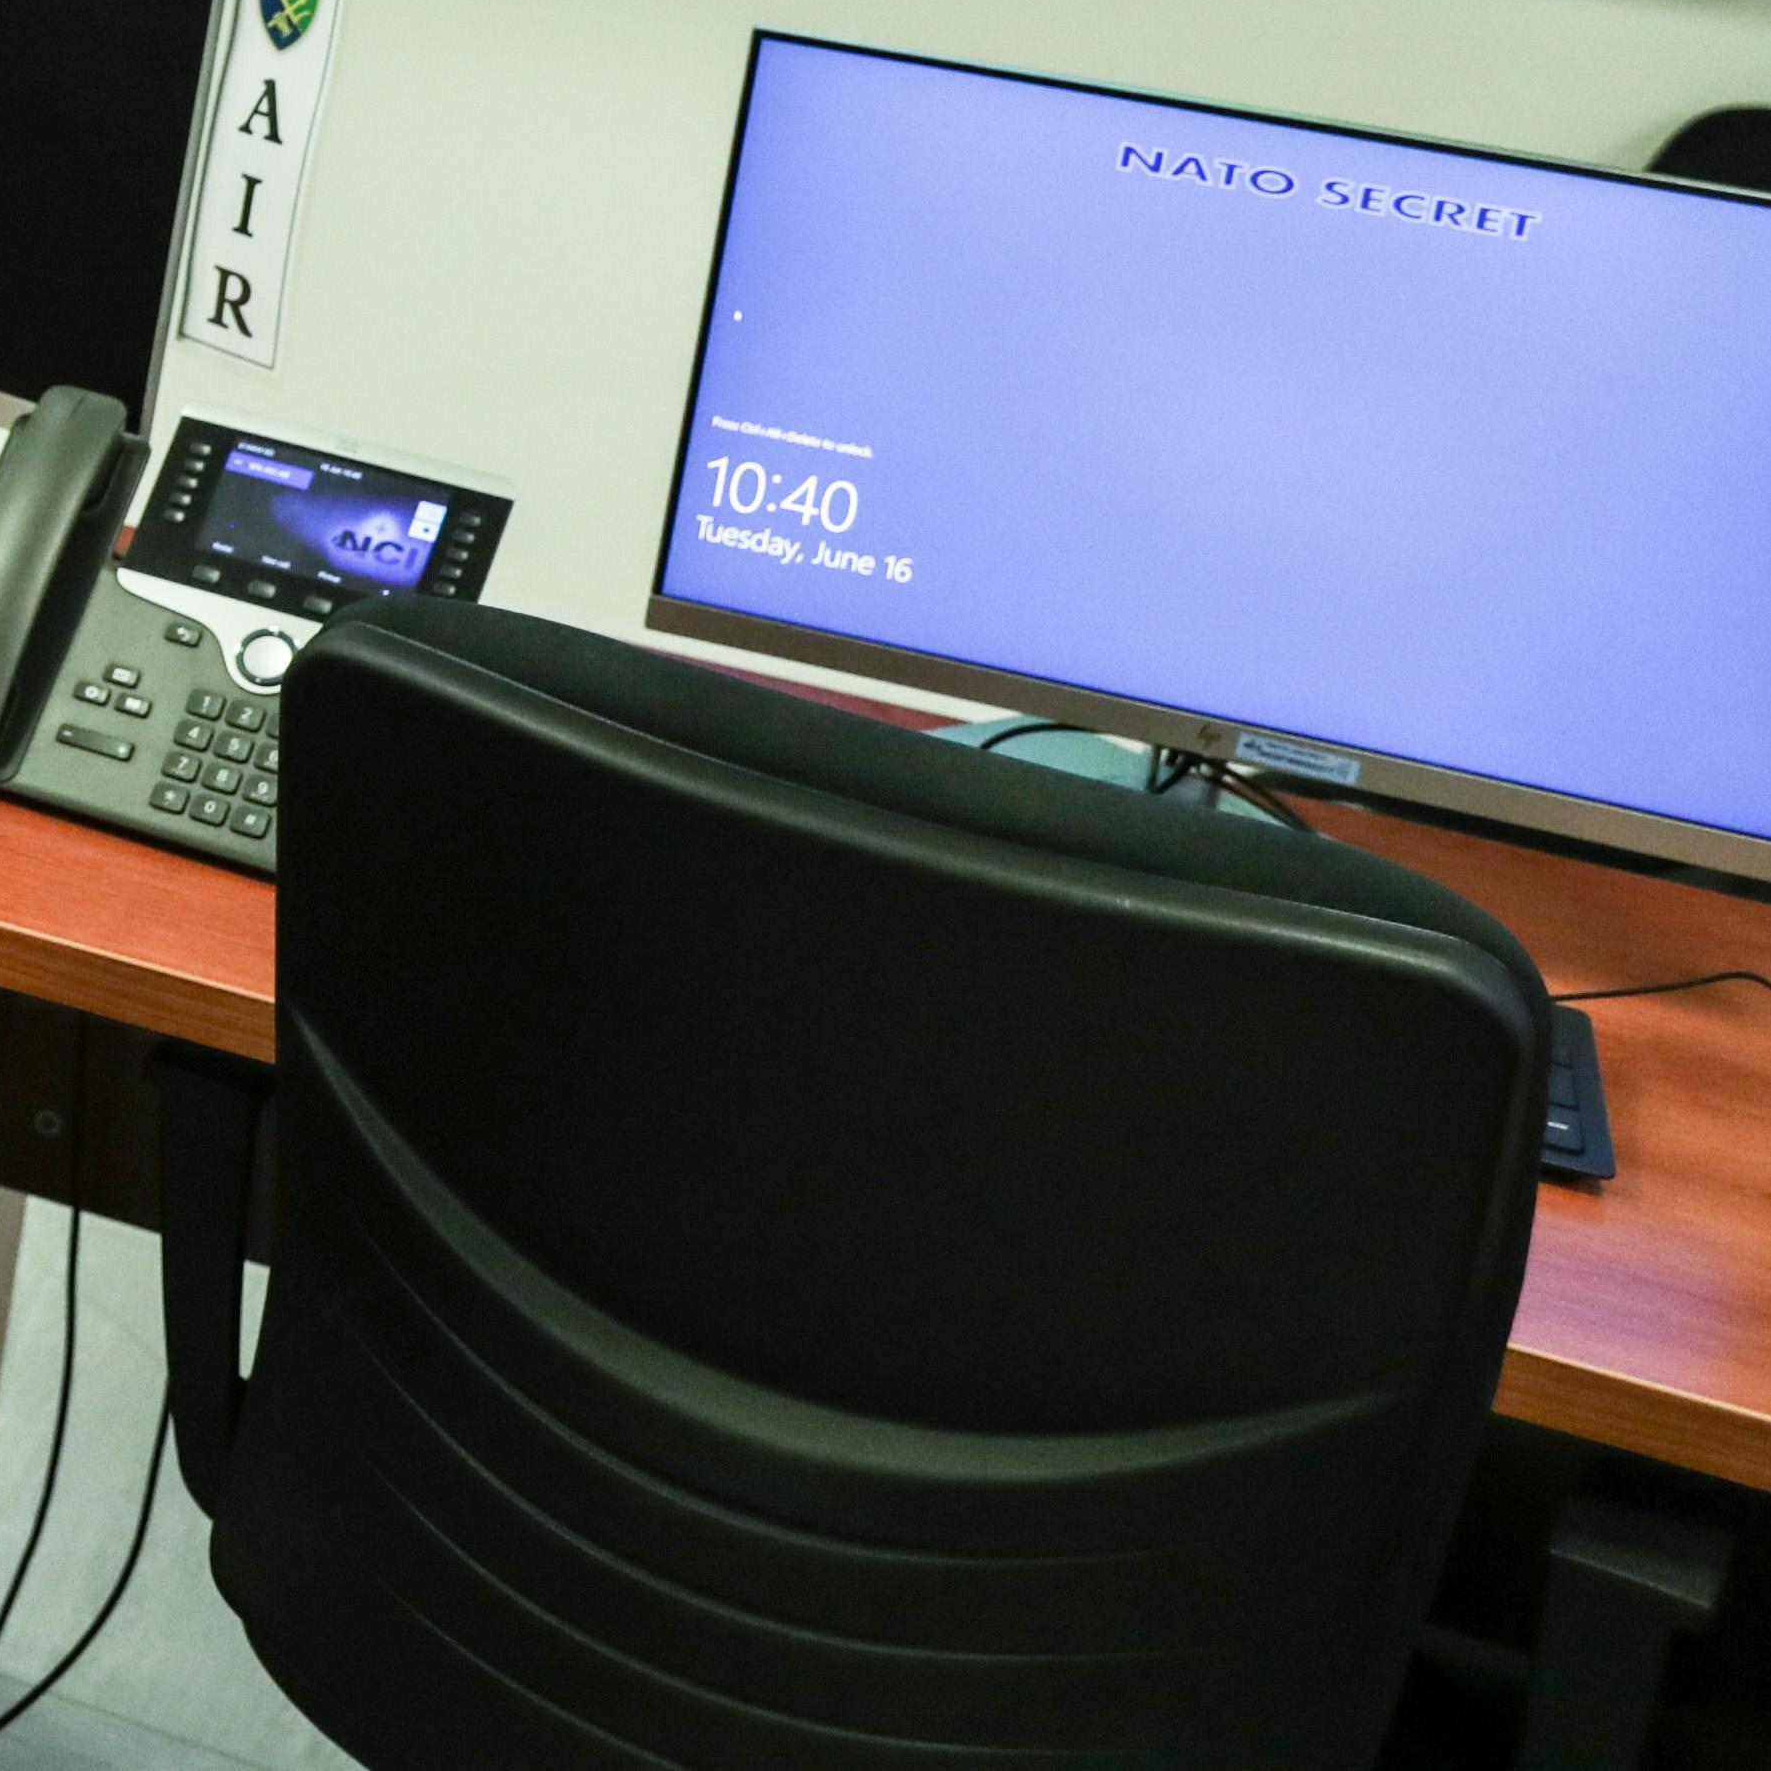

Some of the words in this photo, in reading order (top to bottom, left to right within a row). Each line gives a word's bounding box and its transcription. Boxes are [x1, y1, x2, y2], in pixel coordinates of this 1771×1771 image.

[206, 78, 283, 338] AIR
[1118, 143, 1296, 197] NATO
[1320, 179, 1538, 238] SECRET
[706, 456, 858, 533] 10:40
[695, 514, 804, 565] Tuesday,
[811, 540, 876, 576] June
[884, 555, 914, 583] 16
[240, 707, 253, 720] 2
[204, 800, 216, 813] 0
